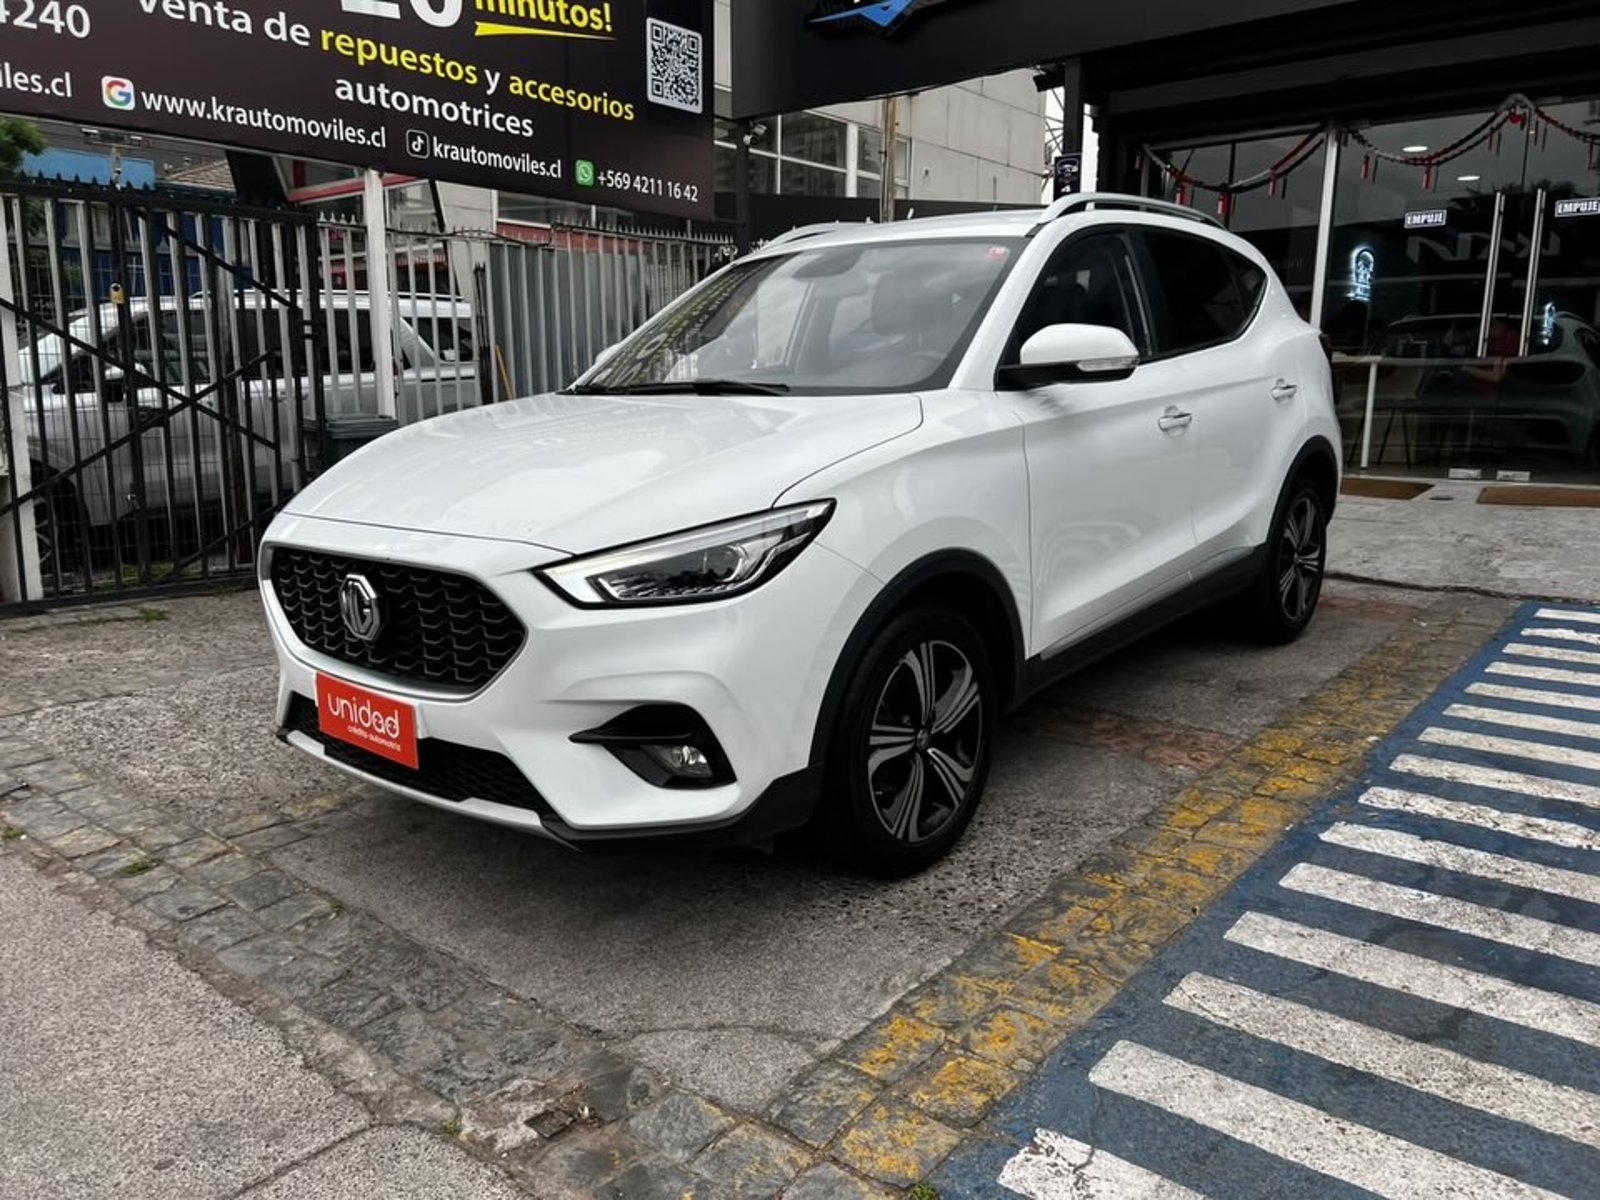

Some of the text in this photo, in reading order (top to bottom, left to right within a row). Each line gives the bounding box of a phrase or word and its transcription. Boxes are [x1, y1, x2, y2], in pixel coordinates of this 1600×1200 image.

[264, 11, 311, 46] de
[321, 29, 478, 84] repuestos
[485, 69, 501, 95] y
[508, 75, 635, 121] accesorios
[141, 89, 387, 148] www.krautomoviles.cl
[335, 78, 534, 137] automotrices
[432, 136, 562, 179] krautomoviles.cl
[597, 169, 698, 202] +569 4211 16 42
[1557, 201, 1599, 214] EMPUJE
